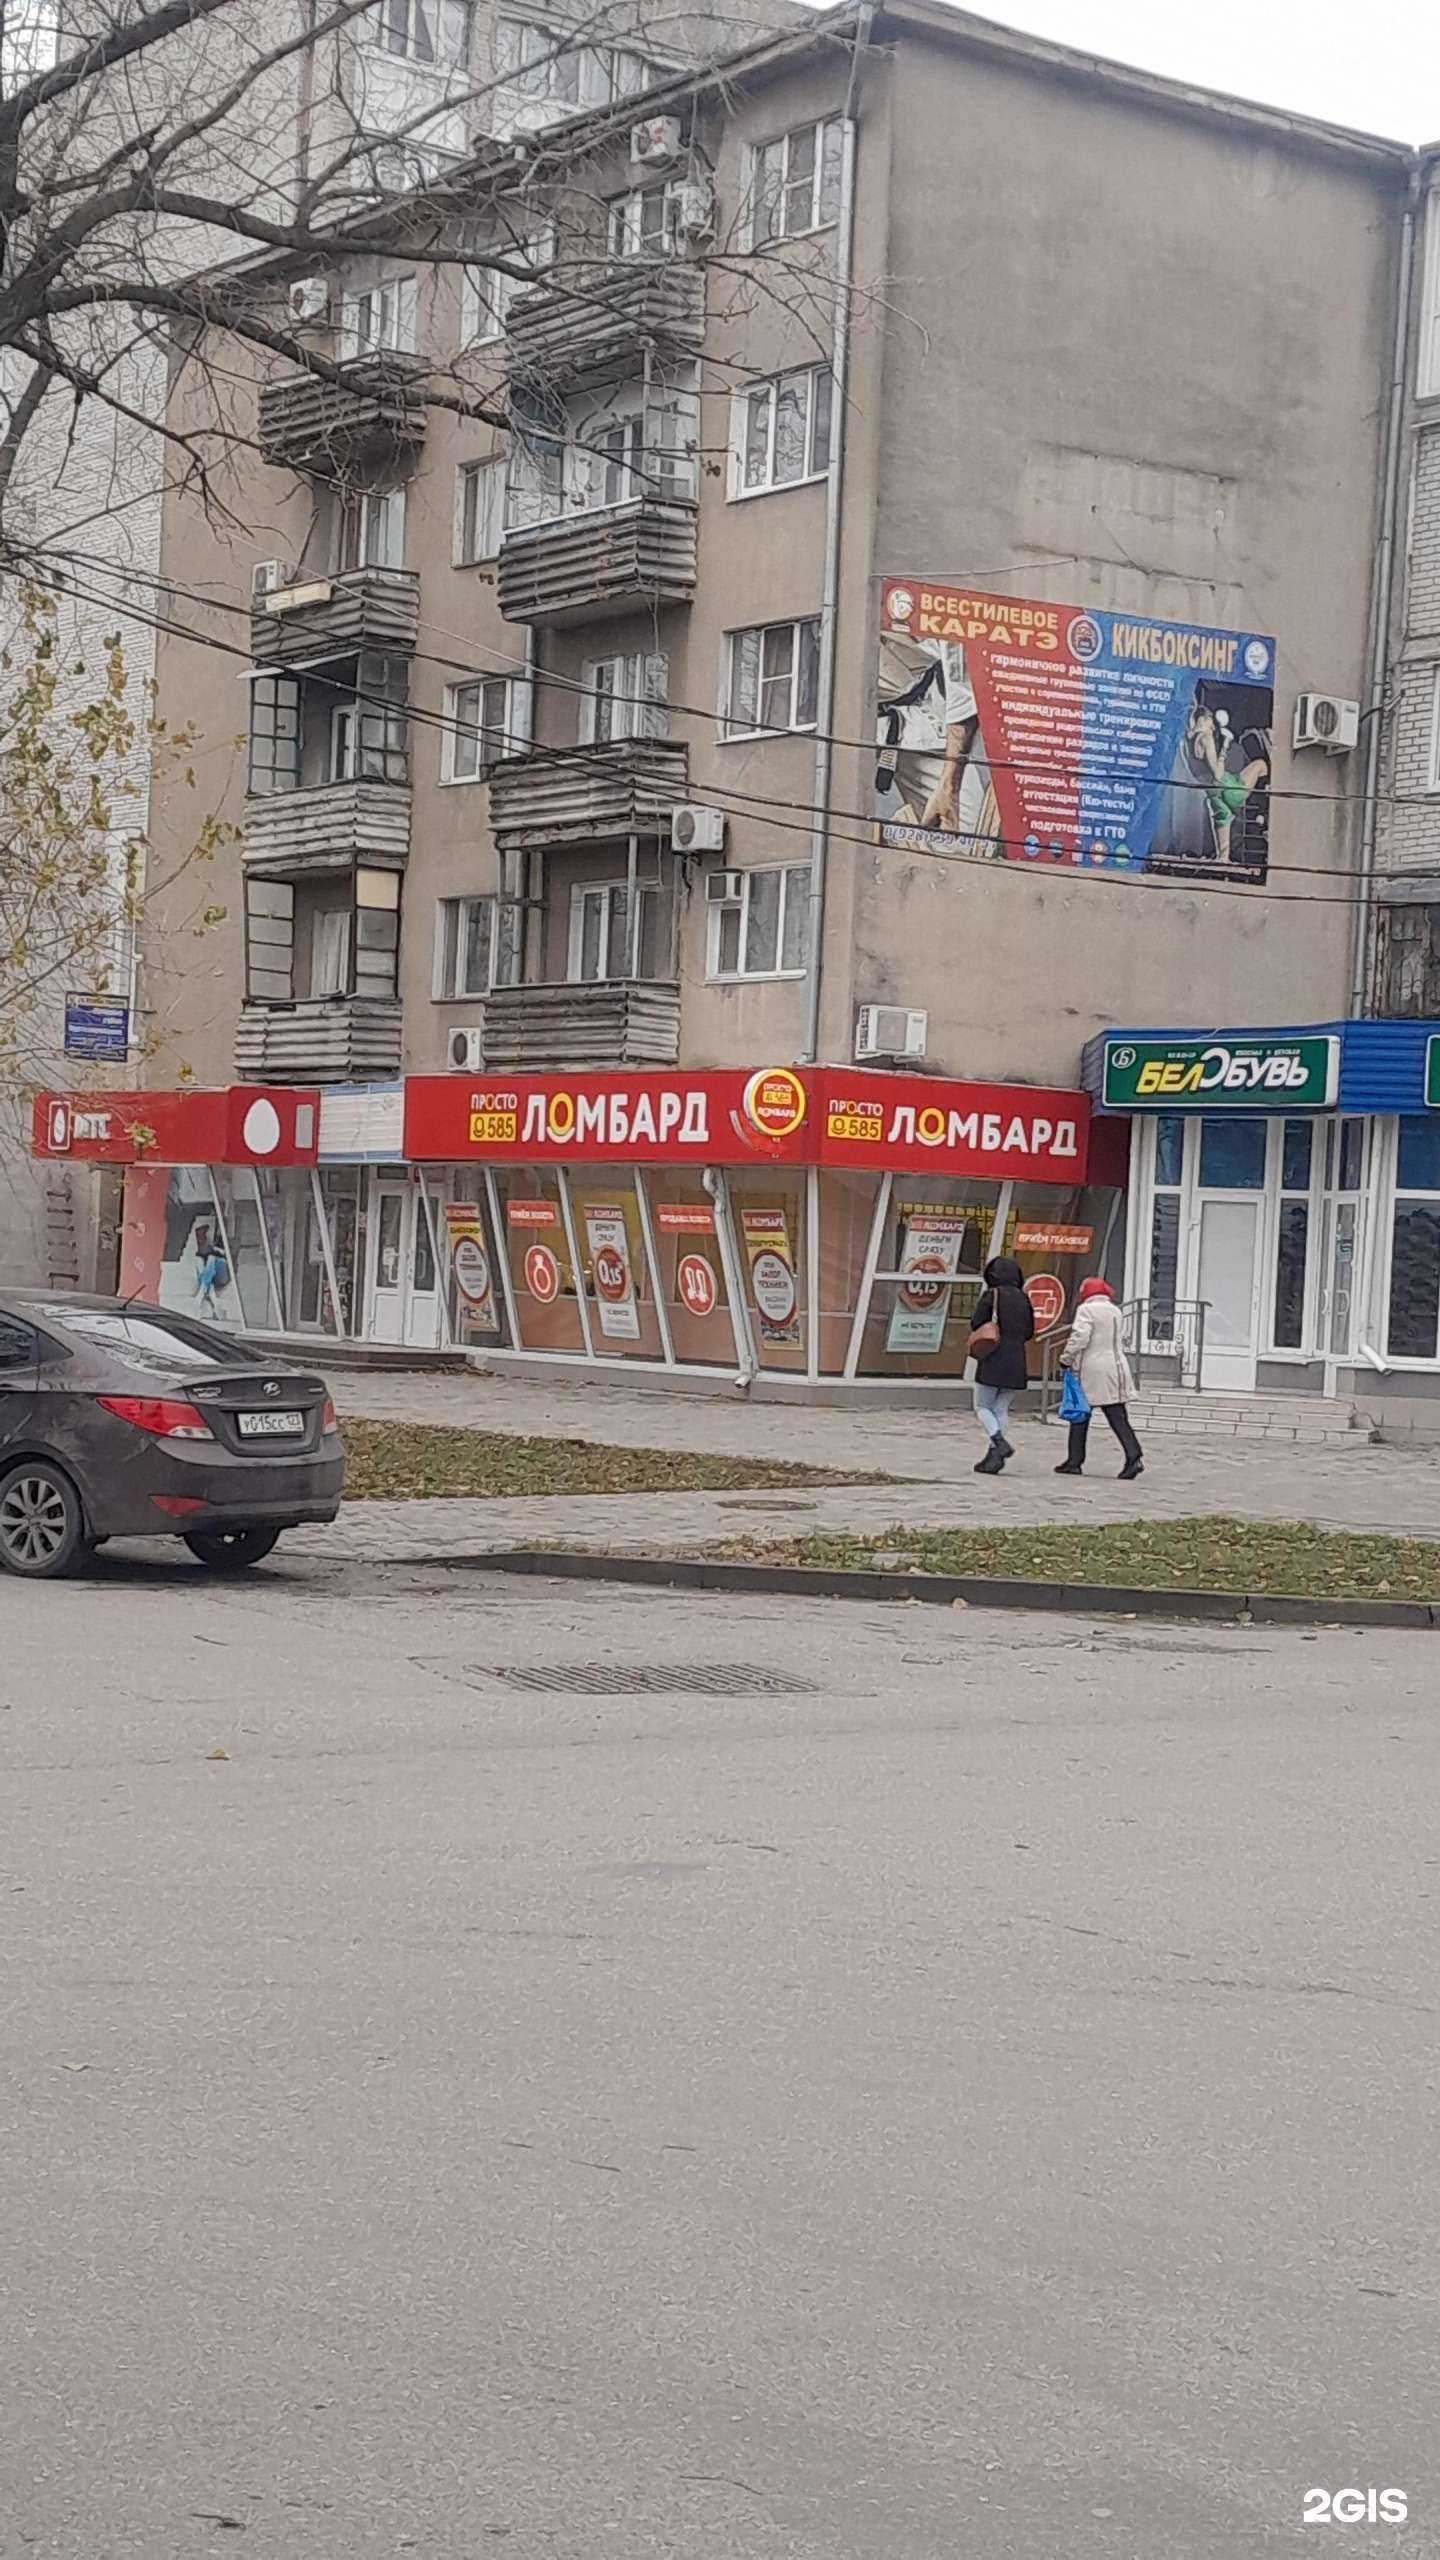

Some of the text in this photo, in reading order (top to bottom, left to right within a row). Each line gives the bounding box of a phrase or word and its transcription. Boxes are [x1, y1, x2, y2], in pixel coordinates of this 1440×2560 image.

[920, 593, 1058, 630] ВСЕСТИЛЕВОЕ
[919, 613, 1059, 650] КАРАТЭ
[1112, 623, 1238, 672] КИКБОКСИНГ
[1104, 826, 1127, 839] ГТО
[471, 1093, 518, 1110] ПРОСТО
[828, 1099, 884, 1117] ПРОСТО
[487, 1116, 514, 1139] 585
[521, 1092, 709, 1144] ЛОМБАРД
[850, 1118, 879, 1139] 585
[887, 1105, 1078, 1156] ЛОМБАРД
